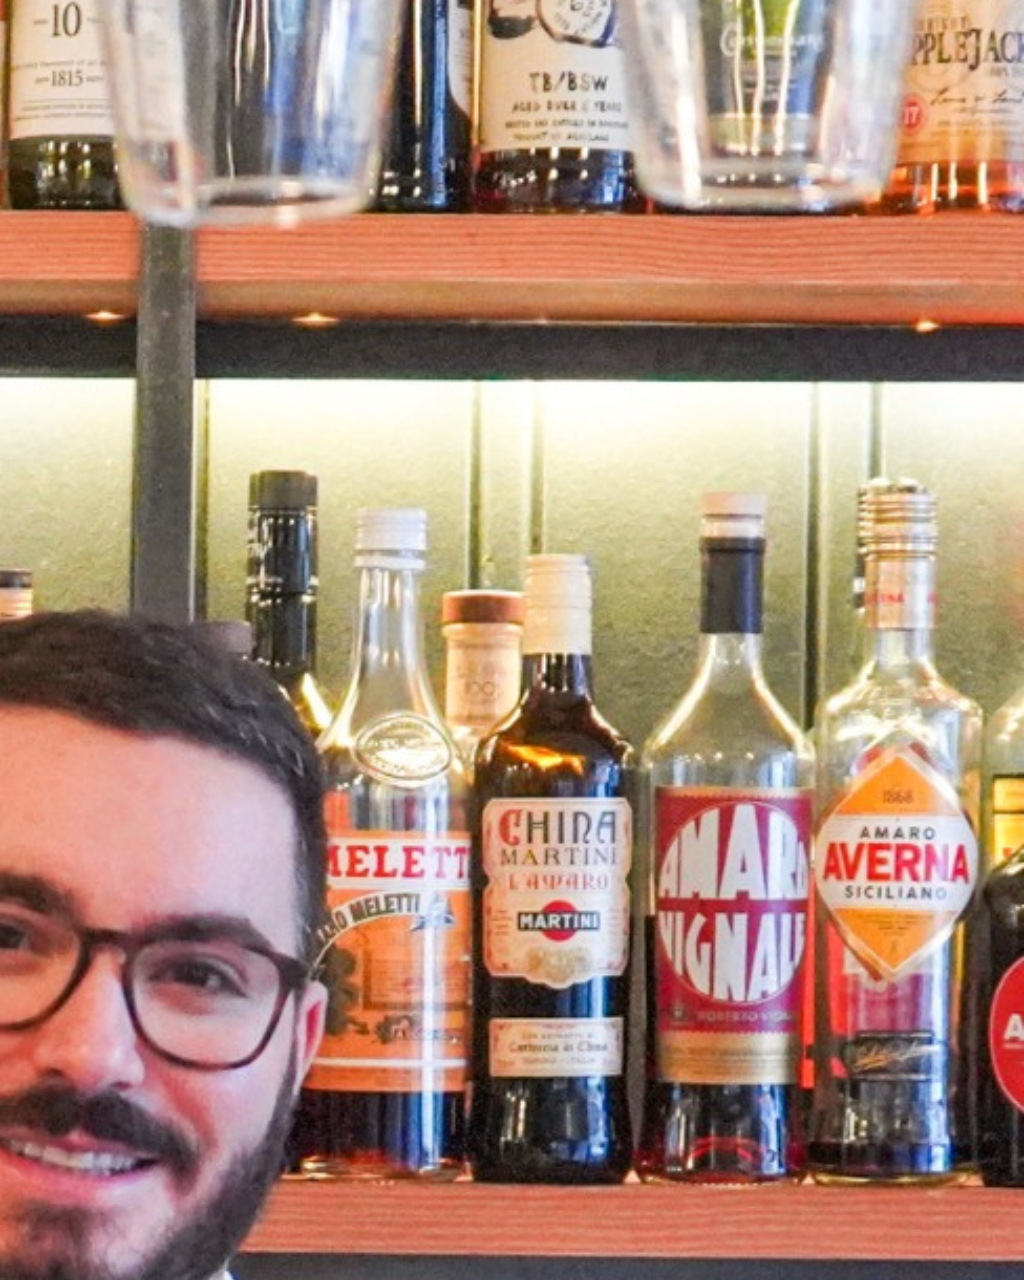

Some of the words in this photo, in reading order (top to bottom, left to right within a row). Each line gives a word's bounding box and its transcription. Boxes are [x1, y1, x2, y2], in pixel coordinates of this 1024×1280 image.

[51, 2, 82, 37] 10
[51, 70, 83, 87] 1815
[498, 809, 617, 846] CHINA
[860, 826, 936, 841] AMARO
[500, 848, 617, 866] MARTINI
[822, 842, 970, 884] AVERNA
[844, 885, 948, 900] SICILIANO
[349, 893, 421, 922] MELETTI
[520, 914, 599, 929] MARTINI
